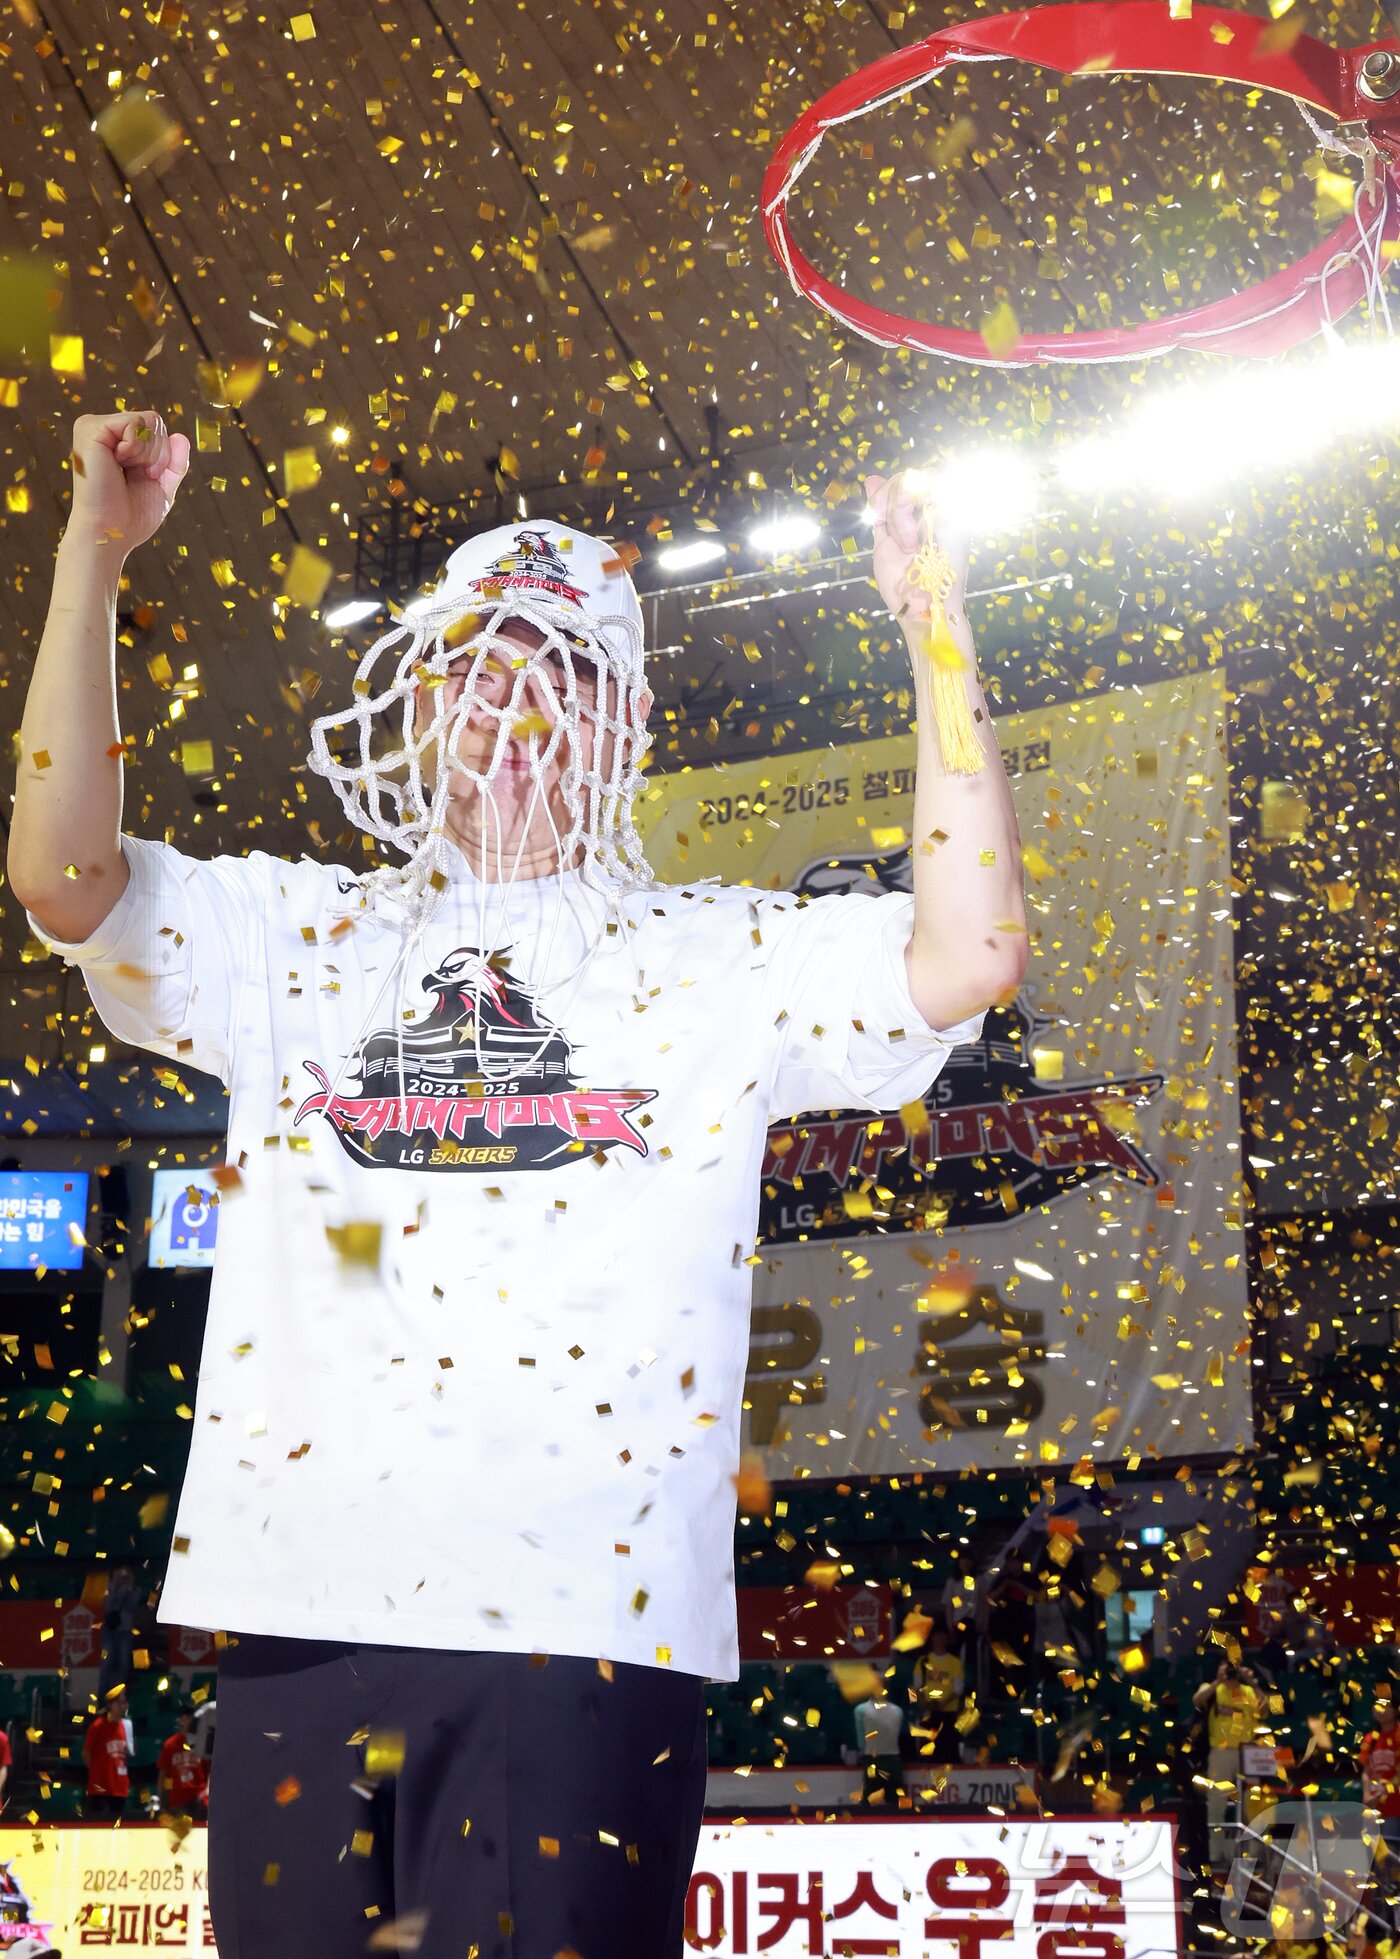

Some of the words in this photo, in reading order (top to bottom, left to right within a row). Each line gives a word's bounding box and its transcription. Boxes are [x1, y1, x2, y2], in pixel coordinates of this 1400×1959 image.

[702, 777, 849, 826] 2024-2025
[863, 769, 917, 800] 챔피
[1000, 741, 1050, 776] 정전
[407, 1078, 520, 1096] 2024-025
[295, 1061, 659, 1158] CHAMPIONS
[762, 1075, 1163, 1187] AMPIONS
[400, 1149, 424, 1164] LG
[428, 1146, 517, 1165] SAKERS
[780, 1204, 815, 1229] LG
[83, 1870, 184, 1891] 2024-2025
[80, 1903, 188, 1945] 챔피언
[685, 1871, 900, 1956] 이커스
[925, 1857, 1126, 1959] 우승
